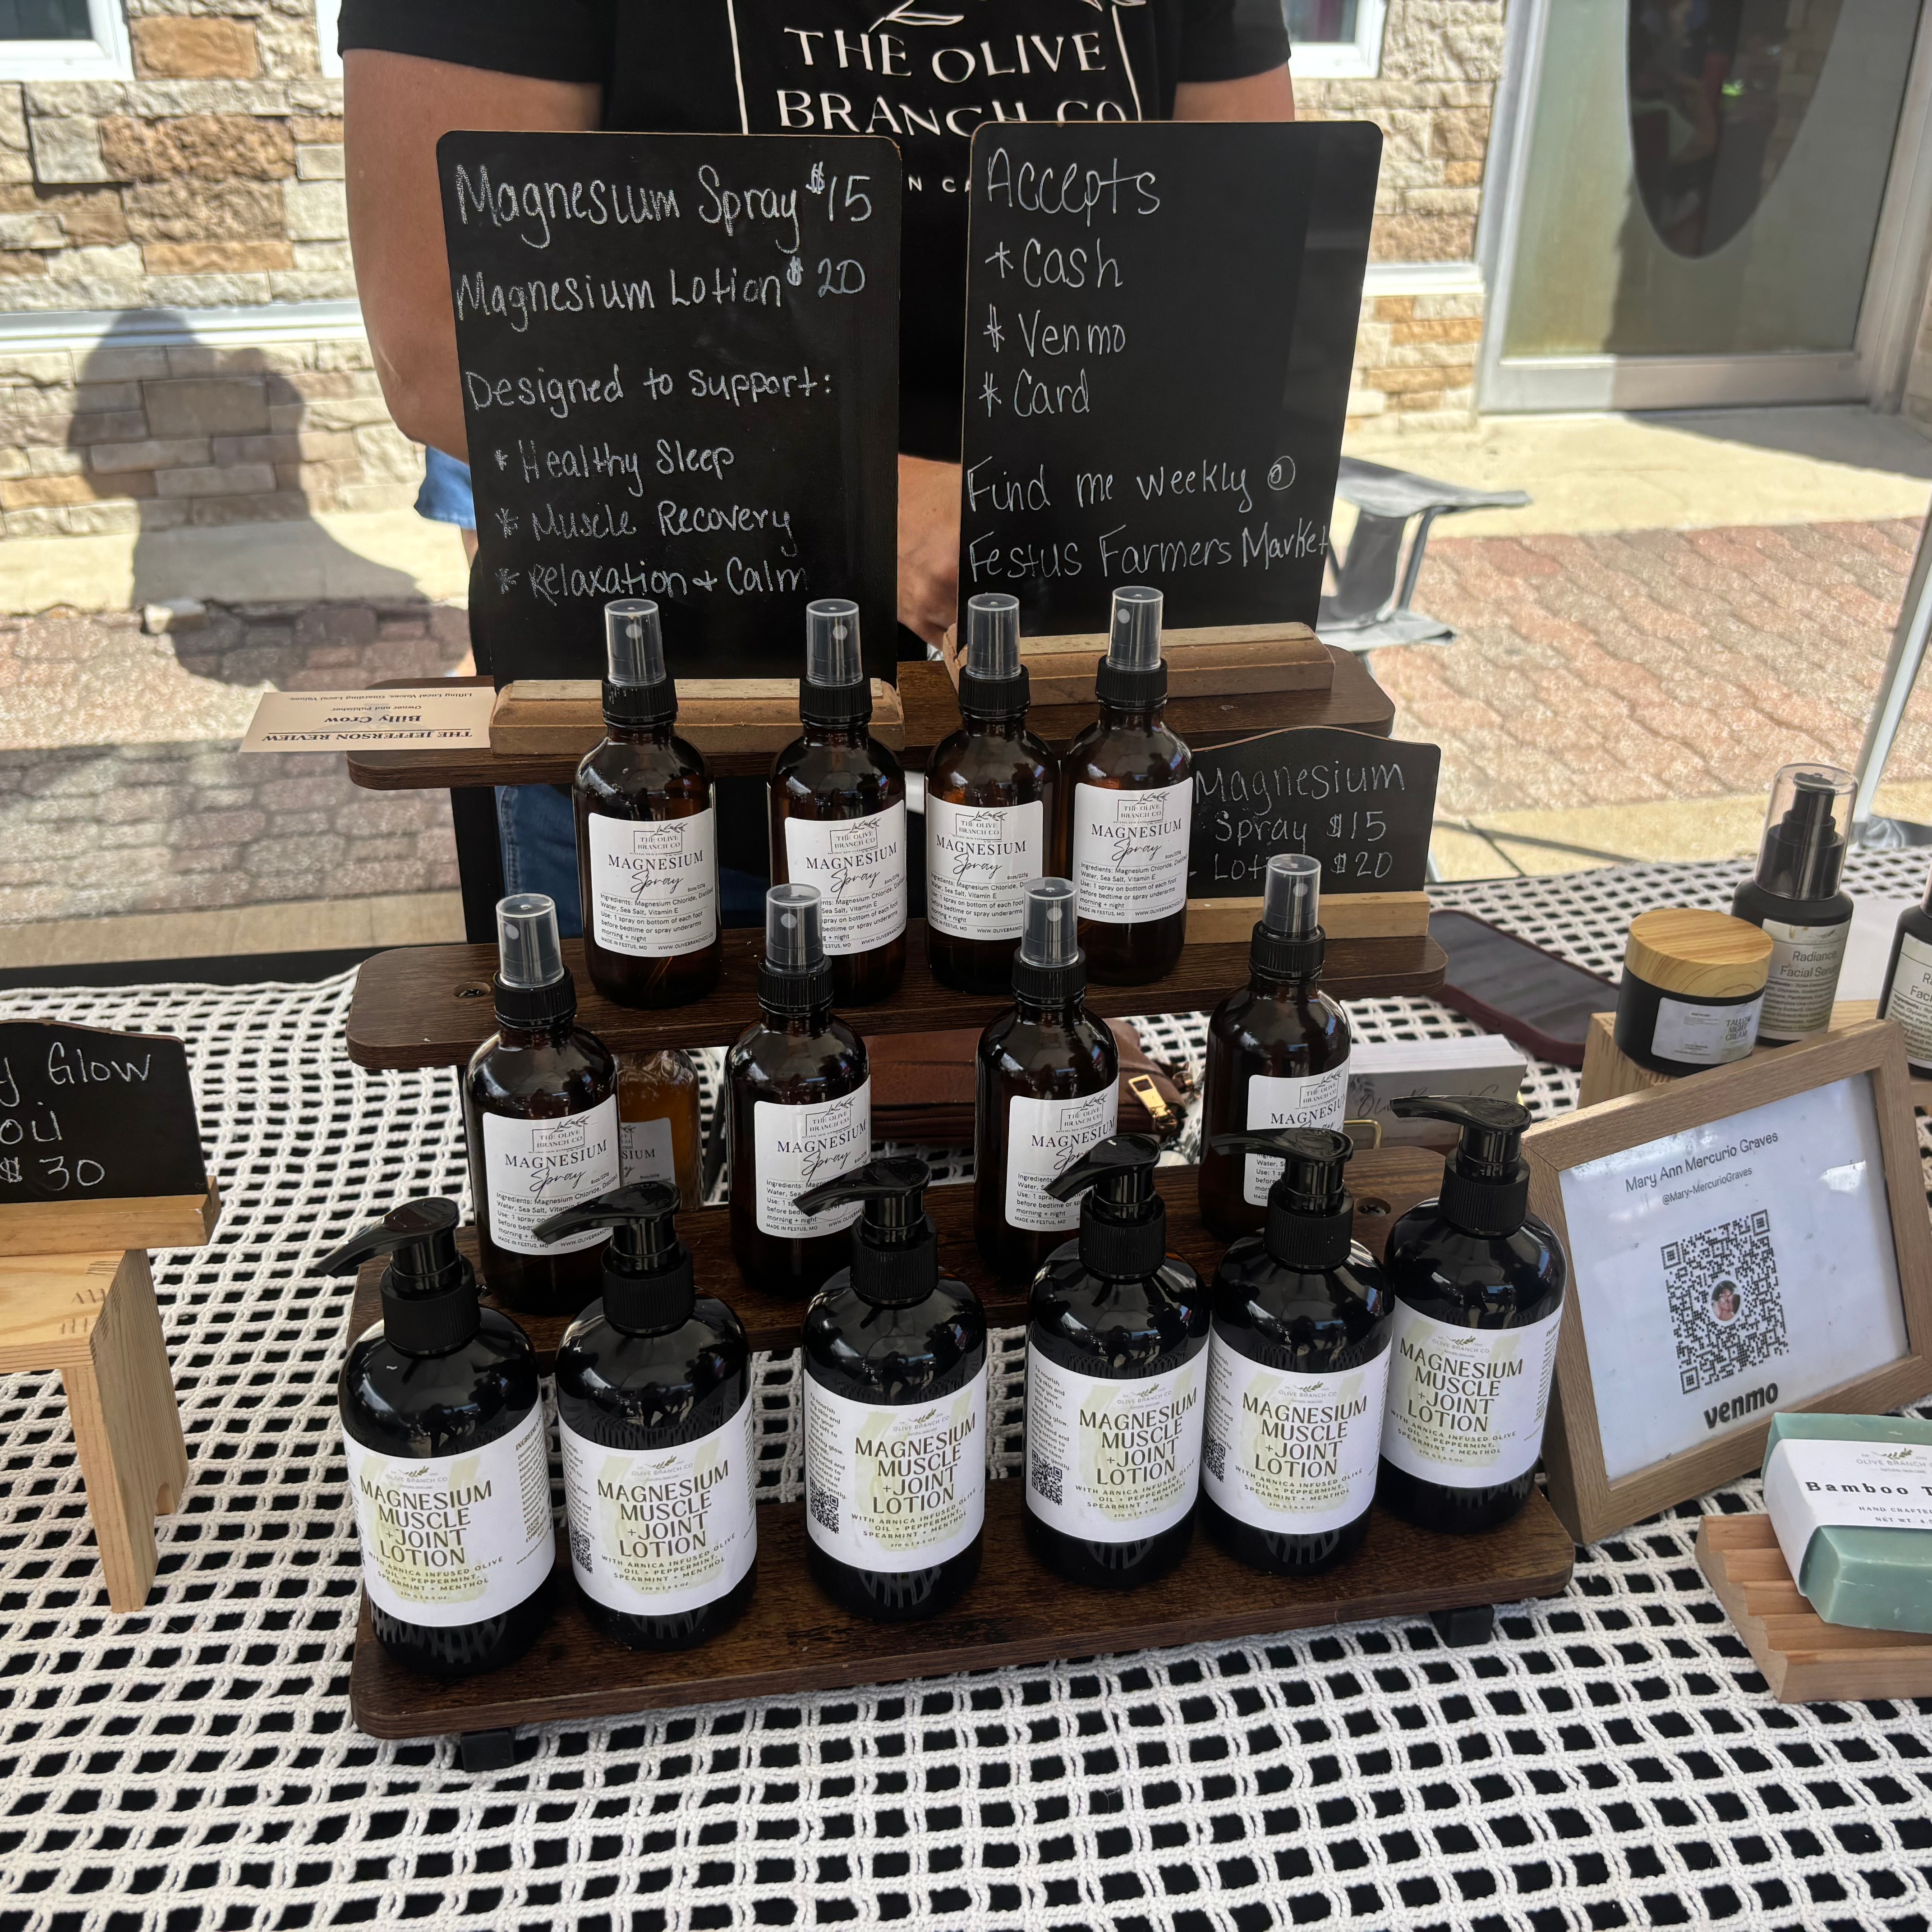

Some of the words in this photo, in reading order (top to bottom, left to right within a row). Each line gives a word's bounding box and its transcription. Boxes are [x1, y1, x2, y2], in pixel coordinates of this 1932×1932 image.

[784, 28, 911, 77] THE
[932, 33, 1106, 83] OLIVE
[776, 90, 1026, 137] BRANCH
[988, 148, 1159, 227] Accepts
[456, 165, 681, 249] Magnesium
[698, 165, 801, 254] Spray
[456, 272, 655, 332] Magnesium
[671, 268, 781, 307] Lotion
[1018, 309, 1125, 357] Venmo
[465, 364, 623, 418] Designed
[643, 368, 673, 400] to
[1014, 369, 1090, 417] Card
[518, 440, 644, 497] Healthy
[656, 439, 735, 480] Sleep
[967, 456, 1051, 512] Find
[1077, 472, 1113, 508] me
[532, 504, 637, 540] Muscle
[658, 500, 798, 557] Recovery
[969, 531, 1082, 581] Festus
[1099, 525, 1232, 577] Farmers
[1242, 518, 1329, 570] Market
[530, 560, 687, 607] Relaxation
[727, 557, 809, 595] Calm
[262, 733, 331, 741] REVIEW
[336, 731, 434, 740] JEFFERSON
[1196, 761, 1404, 815] Magnesium
[1092, 818, 1182, 838] MAGNESIUM
[1215, 812, 1307, 854] Spray
[1327, 811, 1386, 841] $15
[608, 851, 703, 870] MAGNESIUM
[806, 842, 897, 869] MAGNESIUM
[936, 834, 1026, 856] MAGNESIUM
[1112, 838, 1162, 868] Spray
[953, 853, 1003, 883] Spray
[1081, 862, 1113, 874] Ingredients:
[1150, 862, 1173, 872] Chloride,
[1081, 871, 1098, 880] Water,
[1331, 852, 1393, 878] $20
[631, 870, 684, 901] Spray
[831, 868, 880, 900] Spray
[1080, 888, 1096, 897] before
[1081, 880, 1091, 888] Use:
[1080, 897, 1101, 907] morning
[1780, 966, 1812, 977] Facial
[1793, 950, 1836, 962] Radiance
[48, 1042, 151, 1085] Glow
[777, 1119, 866, 1153] MAGNESIUM
[1031, 1116, 1115, 1147] MAGNESIUM
[505, 1139, 607, 1168] MAGNESIUM
[801, 1151, 851, 1183] Spray
[1625, 1173, 1657, 1192] Mary
[1660, 1164, 1683, 1180] Ann
[1684, 1145, 1737, 1172] Mercurio
[1739, 1132, 1778, 1153] Graves
[530, 1168, 587, 1200] Spray
[1662, 1167, 1753, 1205] @Mary-MercurioGraves
[1400, 1338, 1523, 1379] MAGNESIUM
[1415, 1366, 1501, 1397] MUSCLE
[1080, 1387, 1196, 1431] MAGNESIUM
[1242, 1392, 1367, 1424] MAGNESIUM
[1408, 1399, 1488, 1432] LOTION
[1704, 1382, 1778, 1429] venmo
[855, 1412, 975, 1458] MAGNESIUM
[1102, 1416, 1182, 1449] MUSCLE
[1261, 1420, 1348, 1442] MUSCLE
[878, 1443, 961, 1477] MUSCLE
[1097, 1455, 1175, 1486] LOTION
[1256, 1454, 1337, 1477] LOTION
[360, 1475, 492, 1510] MAGNESIUM
[598, 1459, 728, 1503] MAGNESIUM
[1805, 1482, 1909, 1495] Bamboo
[621, 1490, 712, 1522] MUSCLE
[874, 1484, 954, 1514] LOTION
[379, 1504, 471, 1529] MUSCLE
[380, 1540, 465, 1567] LOTION
[602, 1555, 623, 1565] WITH
[669, 1550, 709, 1566] INFUSED
[713, 1533, 736, 1551] OLIVE
[620, 1531, 706, 1558] LOTION
[614, 1573, 668, 1582] SPEARMINT
[683, 1557, 726, 1578] MENTHOL
